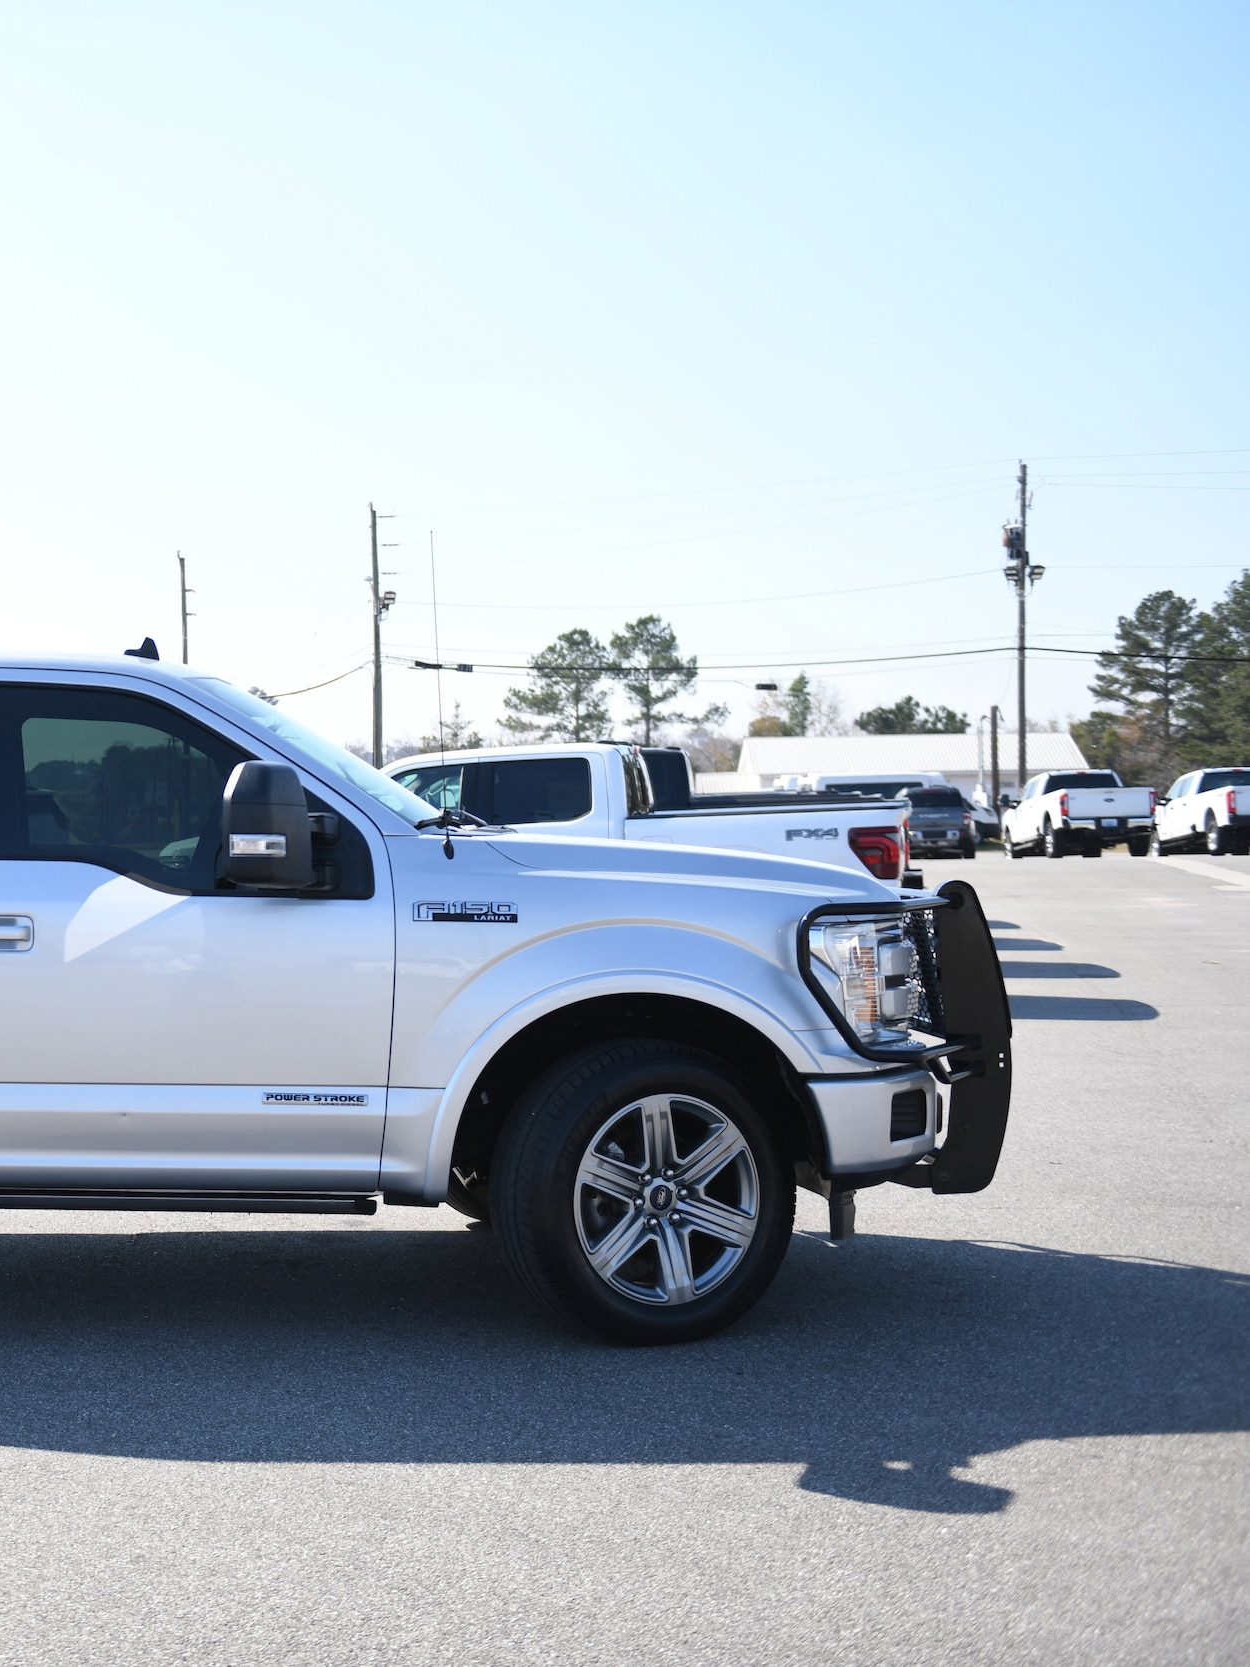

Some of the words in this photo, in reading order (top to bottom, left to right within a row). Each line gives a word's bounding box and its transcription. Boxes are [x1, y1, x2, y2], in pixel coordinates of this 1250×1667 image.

[785, 828, 839, 841] FX4
[266, 1093, 310, 1102] POWER
[313, 1095, 365, 1103] STROKE
